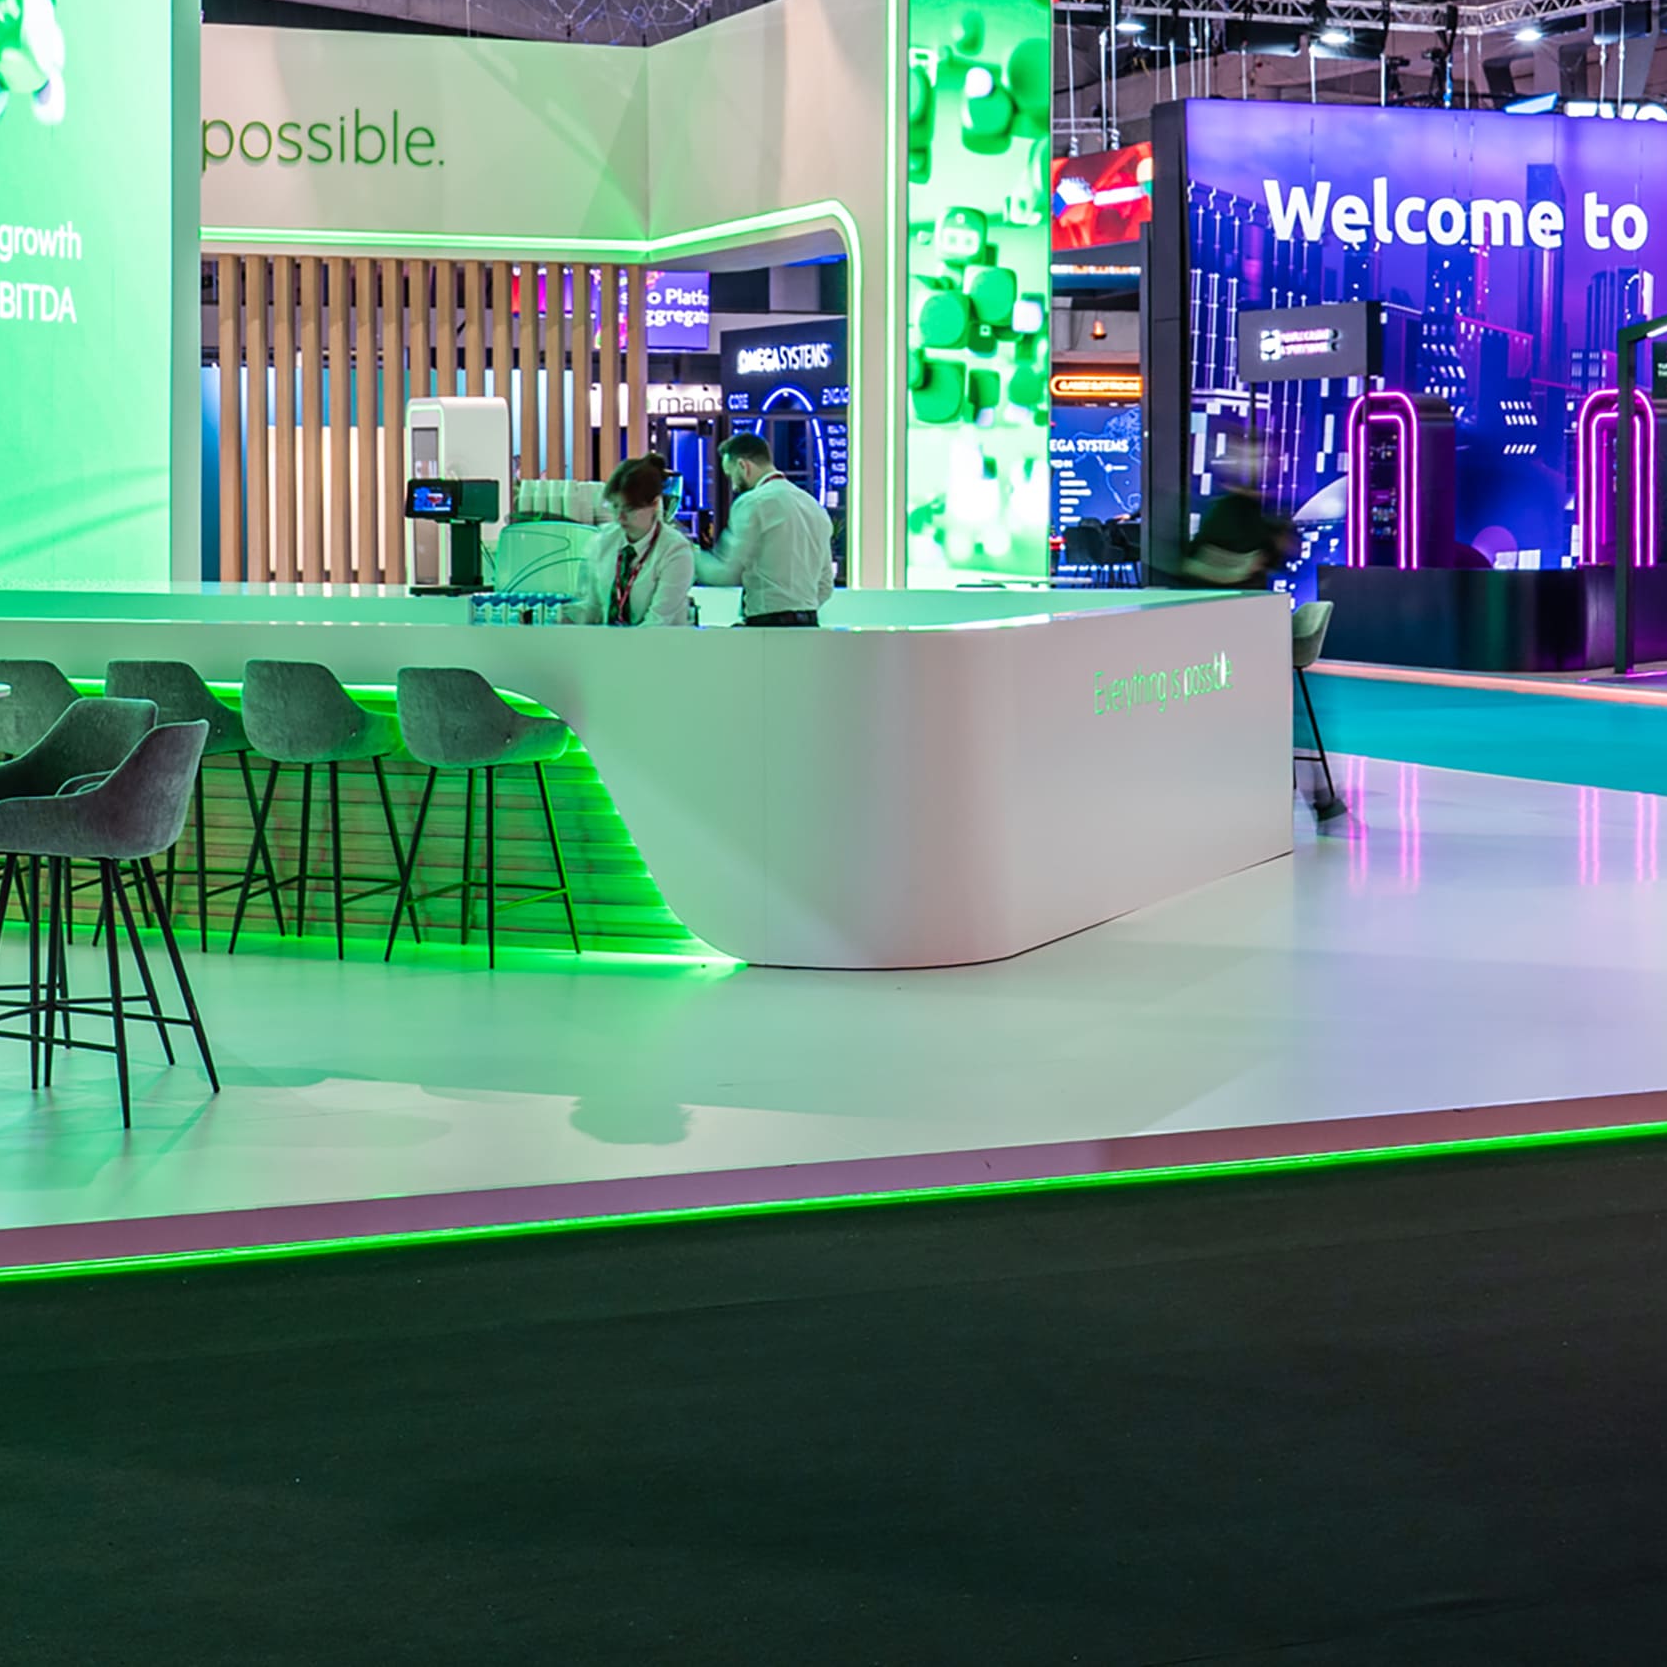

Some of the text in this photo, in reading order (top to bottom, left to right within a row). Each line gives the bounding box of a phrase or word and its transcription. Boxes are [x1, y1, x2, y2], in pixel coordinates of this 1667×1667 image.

[201, 108, 444, 172] possible.
[1263, 176, 1564, 249] Welcome
[1583, 191, 1648, 251] to
[1050, 439, 1075, 452] EGA
